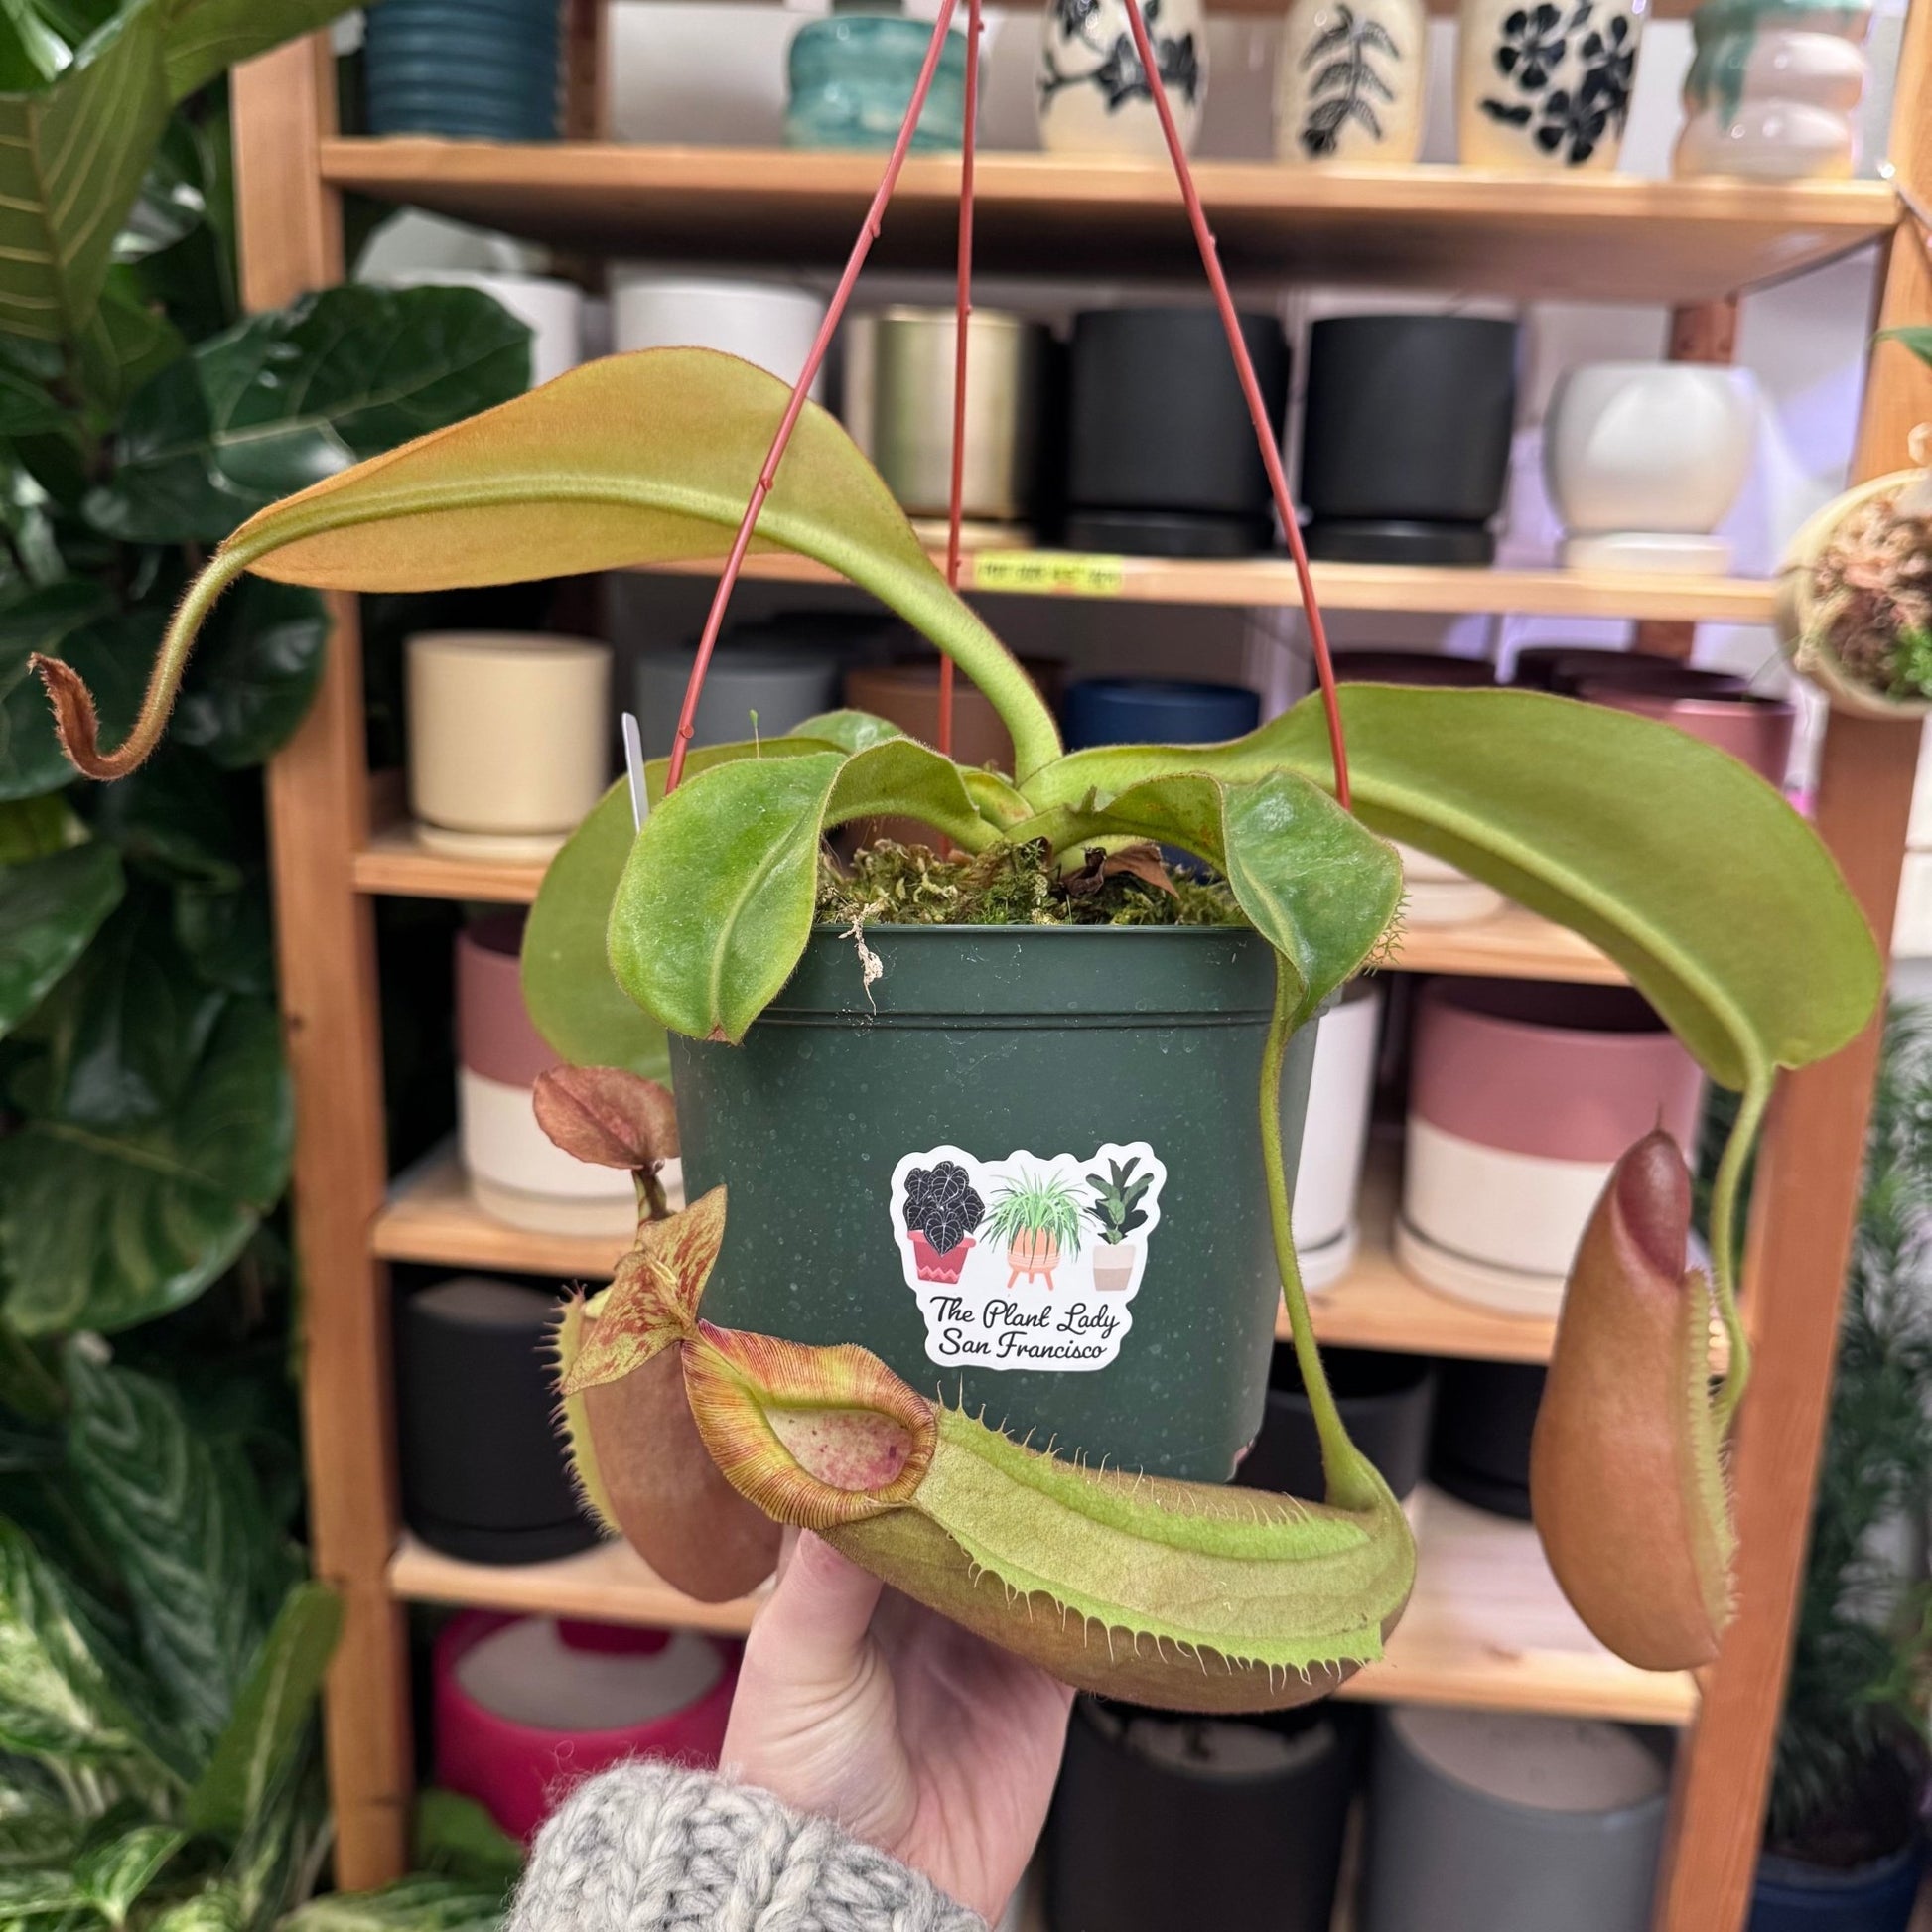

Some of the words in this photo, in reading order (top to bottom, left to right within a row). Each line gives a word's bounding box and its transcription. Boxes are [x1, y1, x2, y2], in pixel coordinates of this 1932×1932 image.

[930, 1296, 975, 1323] The
[983, 1299, 1052, 1329] Plant
[1056, 1303, 1120, 1339] Lady
[939, 1328, 991, 1356] San
[996, 1331, 1107, 1359] Francisco
